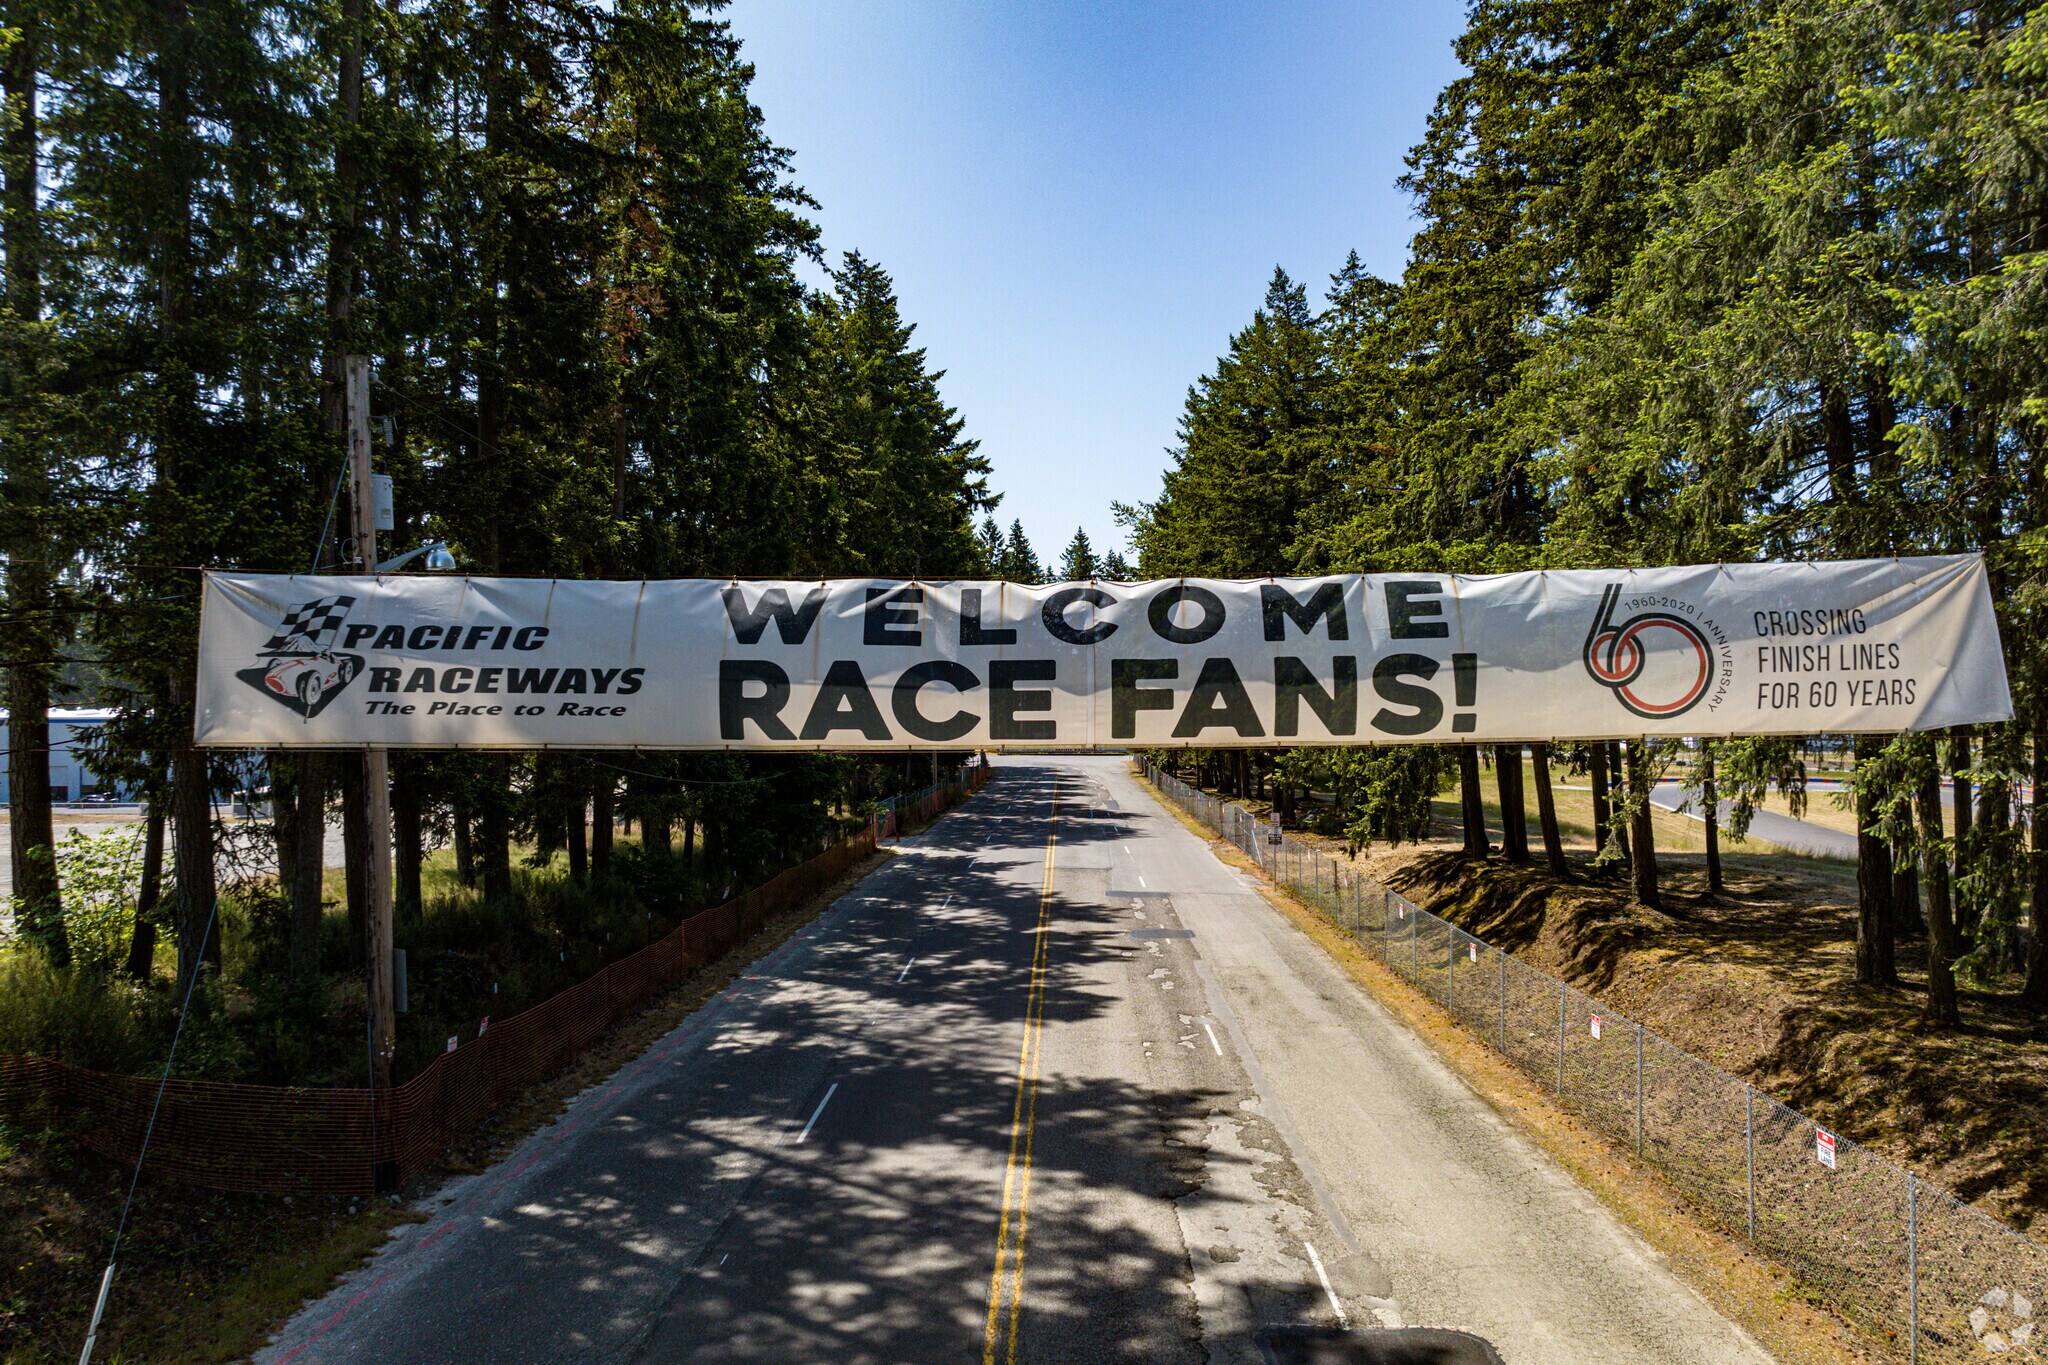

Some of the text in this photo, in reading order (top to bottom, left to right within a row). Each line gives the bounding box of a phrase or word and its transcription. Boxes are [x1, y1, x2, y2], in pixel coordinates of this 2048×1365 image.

[724, 582, 1449, 645] WELCOME
[1754, 608, 1867, 637] CROSSING
[343, 624, 550, 651] PACIFIC
[1624, 596, 1732, 713] 1960-2020 ANNIVERSARY
[1758, 643, 1900, 673] FINISH LINES
[369, 667, 646, 695] RACEWAYS
[1758, 678, 1917, 709] FOR 60 YEARS
[365, 701, 627, 717] The Place to Race
[719, 653, 1479, 741] RACE FANS!
